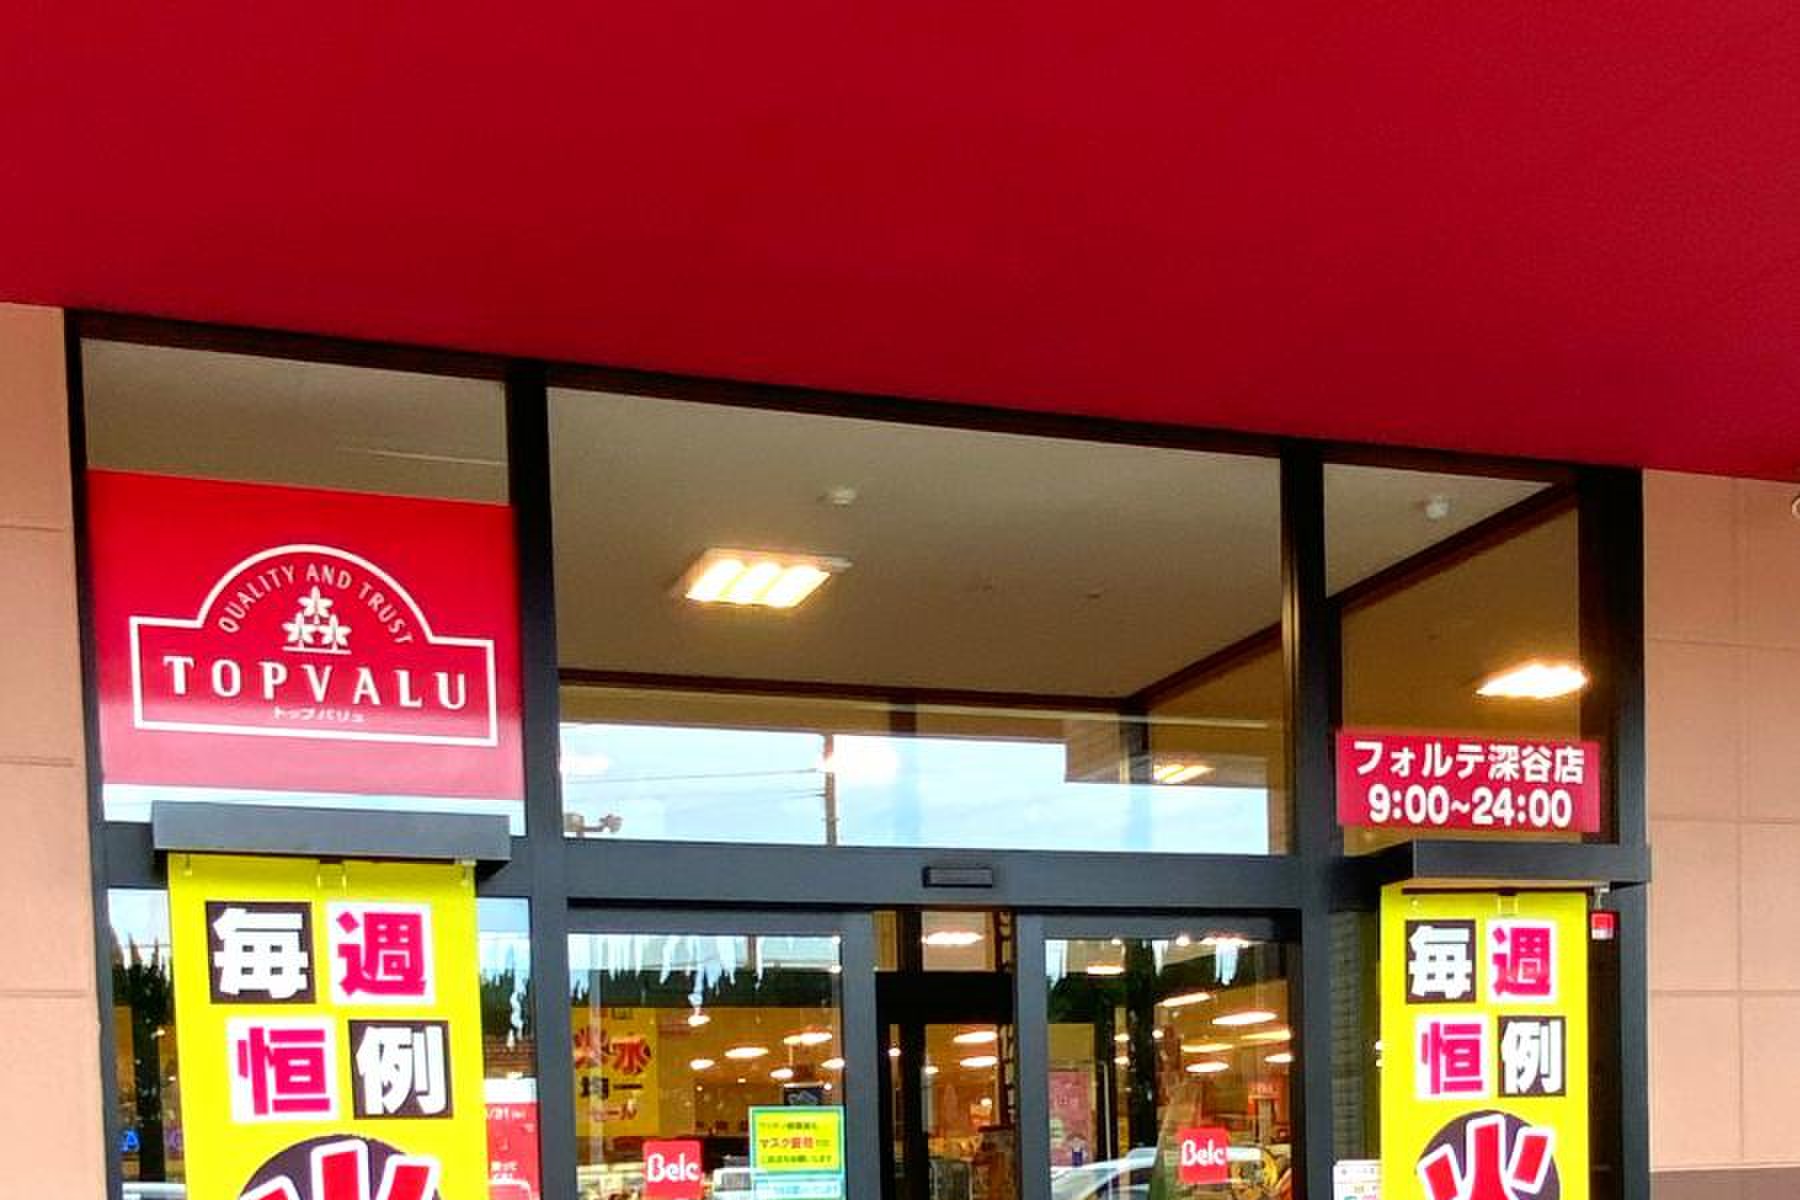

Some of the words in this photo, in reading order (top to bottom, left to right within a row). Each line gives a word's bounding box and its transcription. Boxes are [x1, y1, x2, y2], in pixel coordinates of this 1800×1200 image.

[218, 564, 296, 634] QUALITY
[305, 562, 353, 589] AND
[359, 582, 414, 645] TRUST
[163, 655, 466, 710] TOPVALU
[1353, 740, 1585, 785] フォルテ深谷店
[213, 907, 427, 998] 毎週
[1408, 925, 1551, 1000] 毎週
[237, 1025, 446, 1116] 恒例
[1421, 1020, 1563, 1095] 恒例
[646, 1152, 700, 1182] Belc
[1180, 1138, 1225, 1168] Belc
